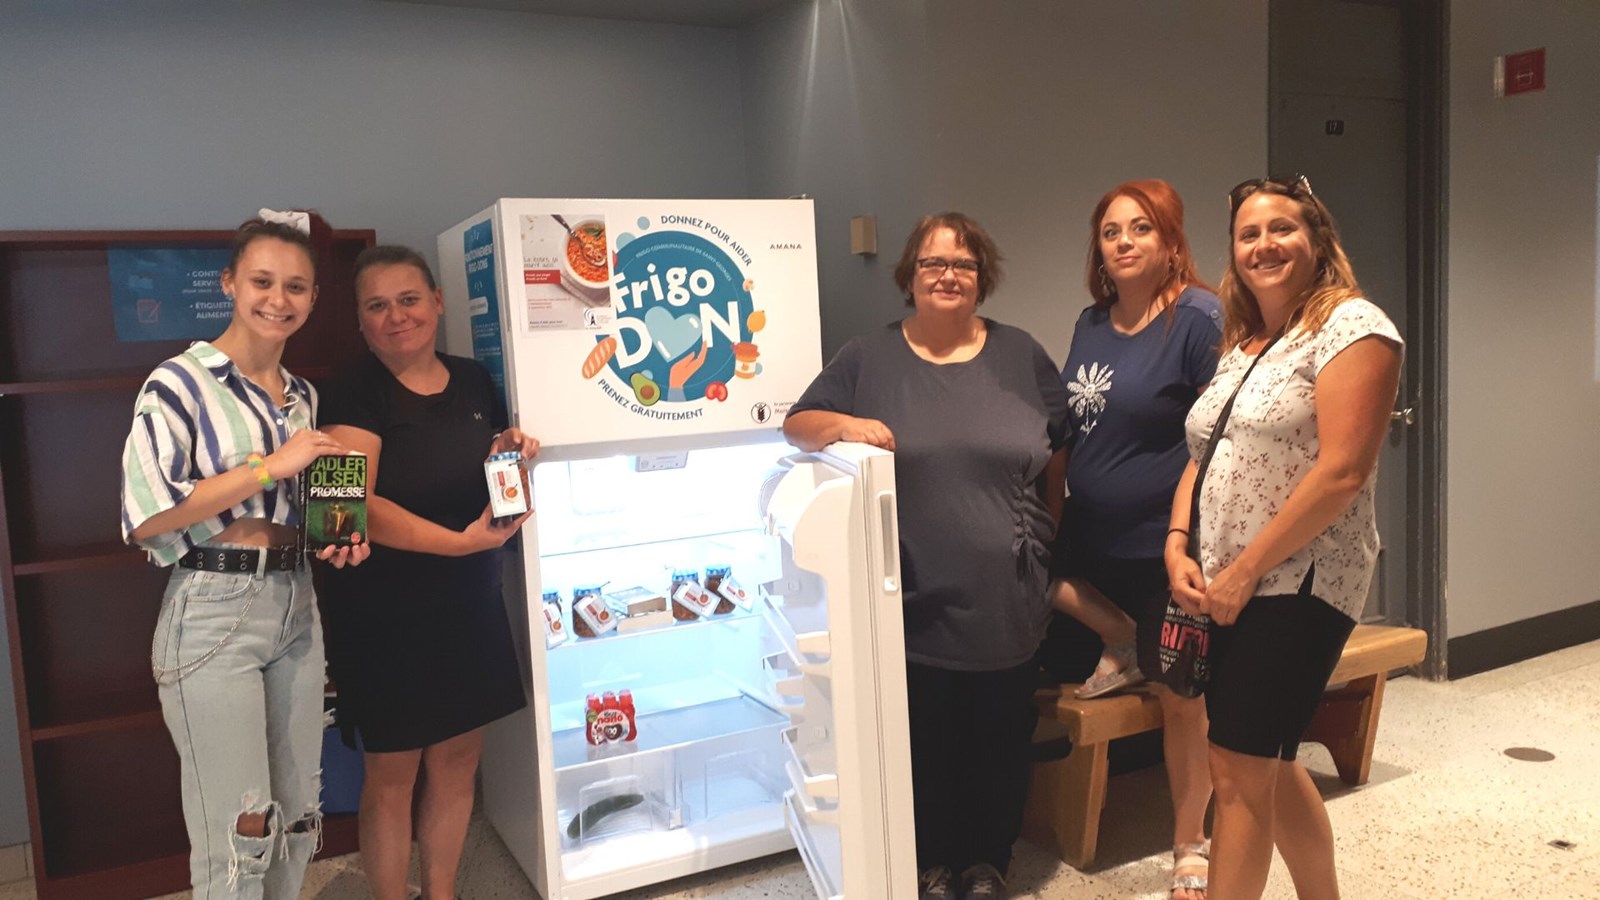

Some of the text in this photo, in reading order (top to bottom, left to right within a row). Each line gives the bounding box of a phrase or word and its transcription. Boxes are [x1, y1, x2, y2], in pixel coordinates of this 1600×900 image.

[660, 215, 752, 267] DONNEZ POUR AIDER
[598, 378, 704, 421] PRENEZ GRATUITEMENT
[315, 457, 366, 471] ADLER
[310, 471, 366, 487] OLSEN
[310, 486, 365, 498] PROMESSE
